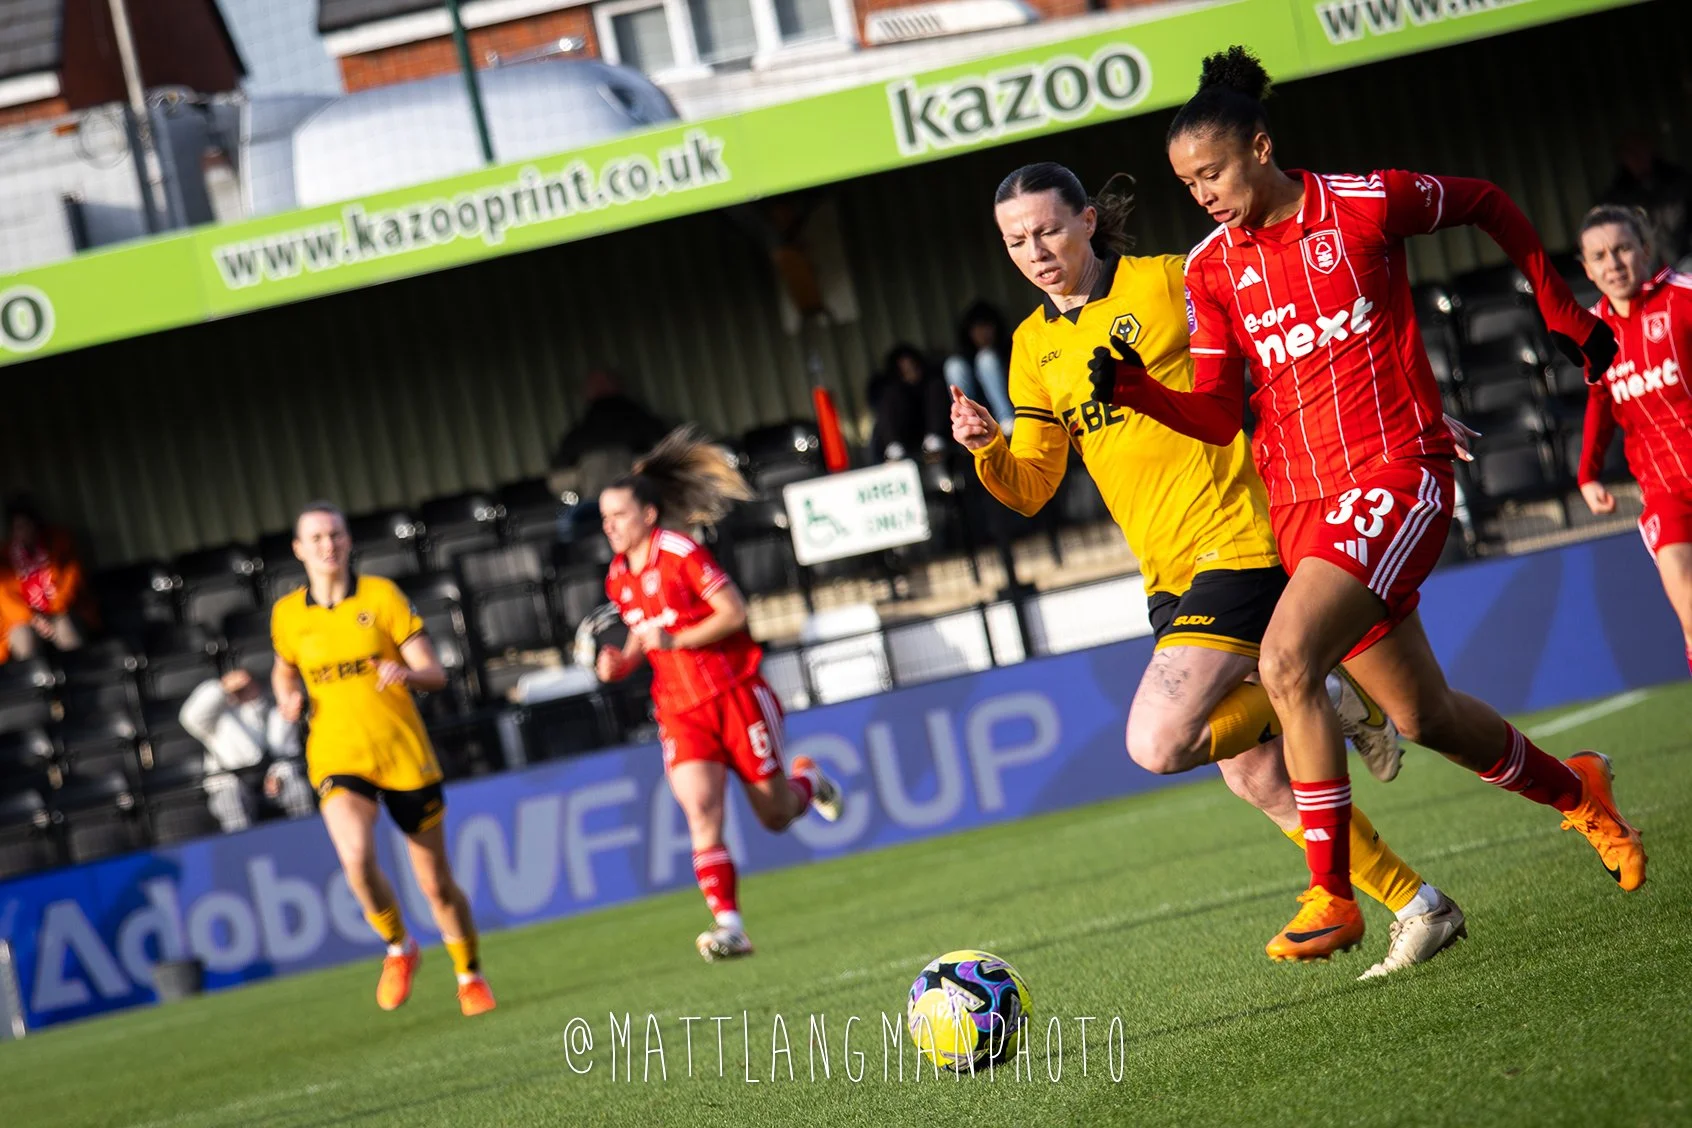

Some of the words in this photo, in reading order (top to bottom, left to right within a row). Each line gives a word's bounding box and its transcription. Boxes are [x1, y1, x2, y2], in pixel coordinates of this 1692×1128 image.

[892, 50, 1145, 150] kazoo
[219, 133, 726, 286] www.kazooprint.co.uk
[1254, 295, 1374, 368] next
[1611, 357, 1680, 405] next
[1325, 487, 1395, 538] 33
[1172, 615, 1216, 627] SUDU
[31, 856, 384, 1013] Adobe
[785, 691, 1061, 852] CUP
